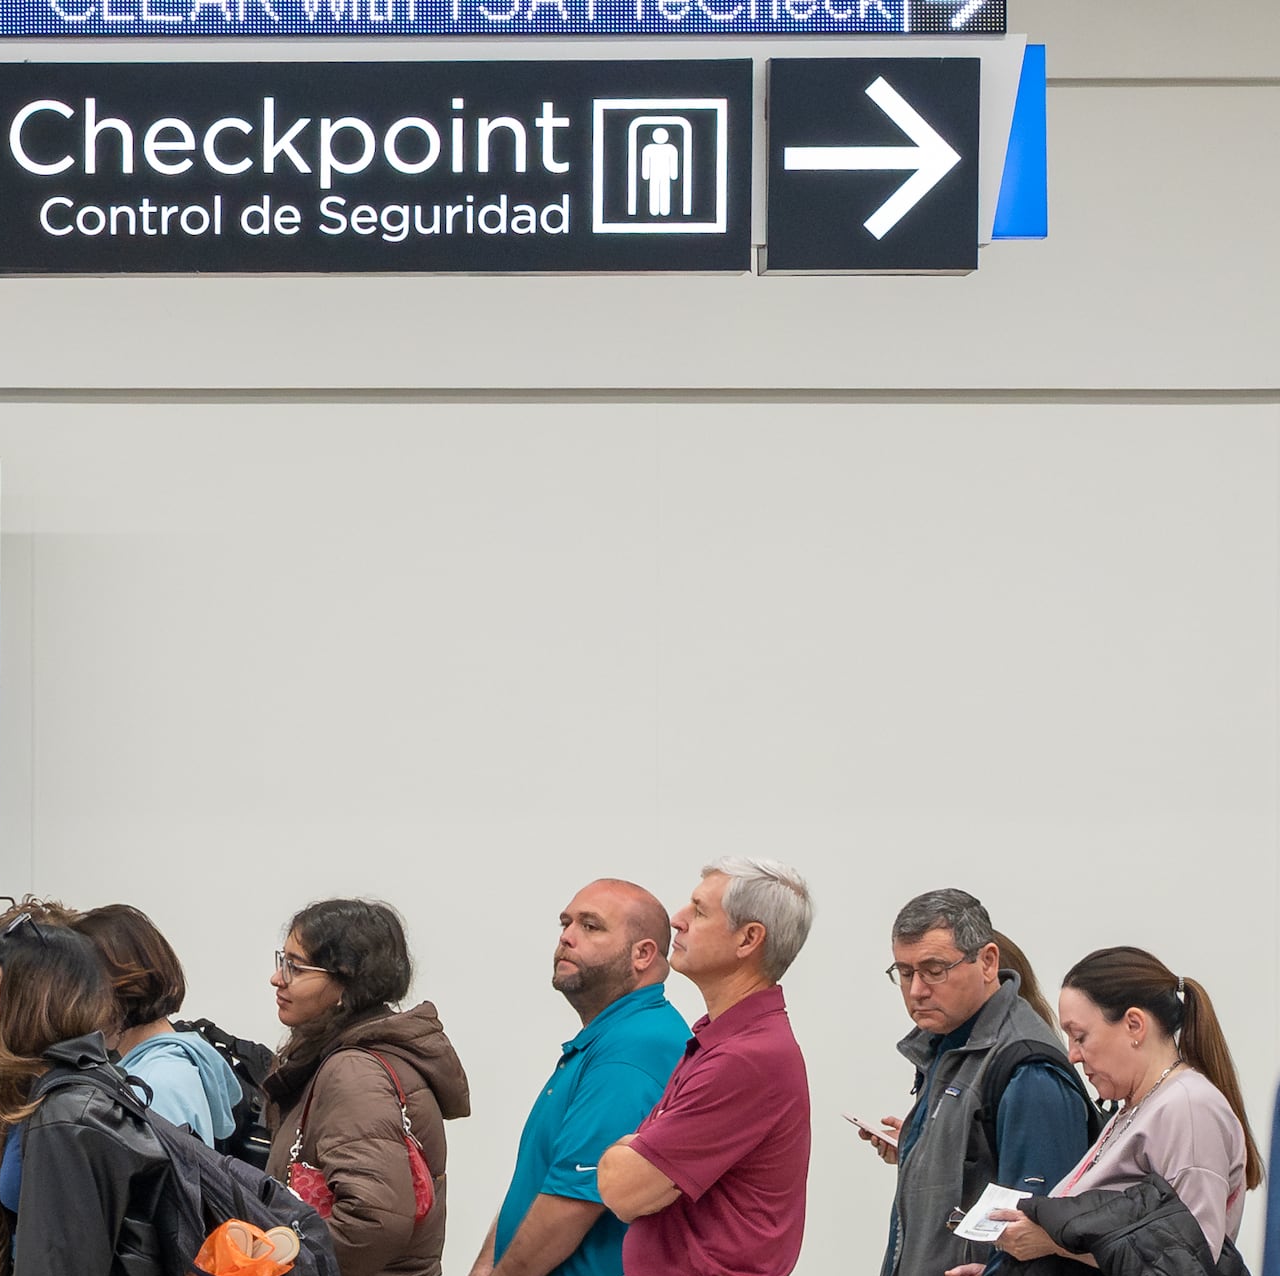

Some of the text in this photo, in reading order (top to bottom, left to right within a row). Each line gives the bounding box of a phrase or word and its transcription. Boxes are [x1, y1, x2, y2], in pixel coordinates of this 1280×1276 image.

[9, 97, 570, 189] Checkpoint
[39, 194, 570, 242] Control de Seguridad
